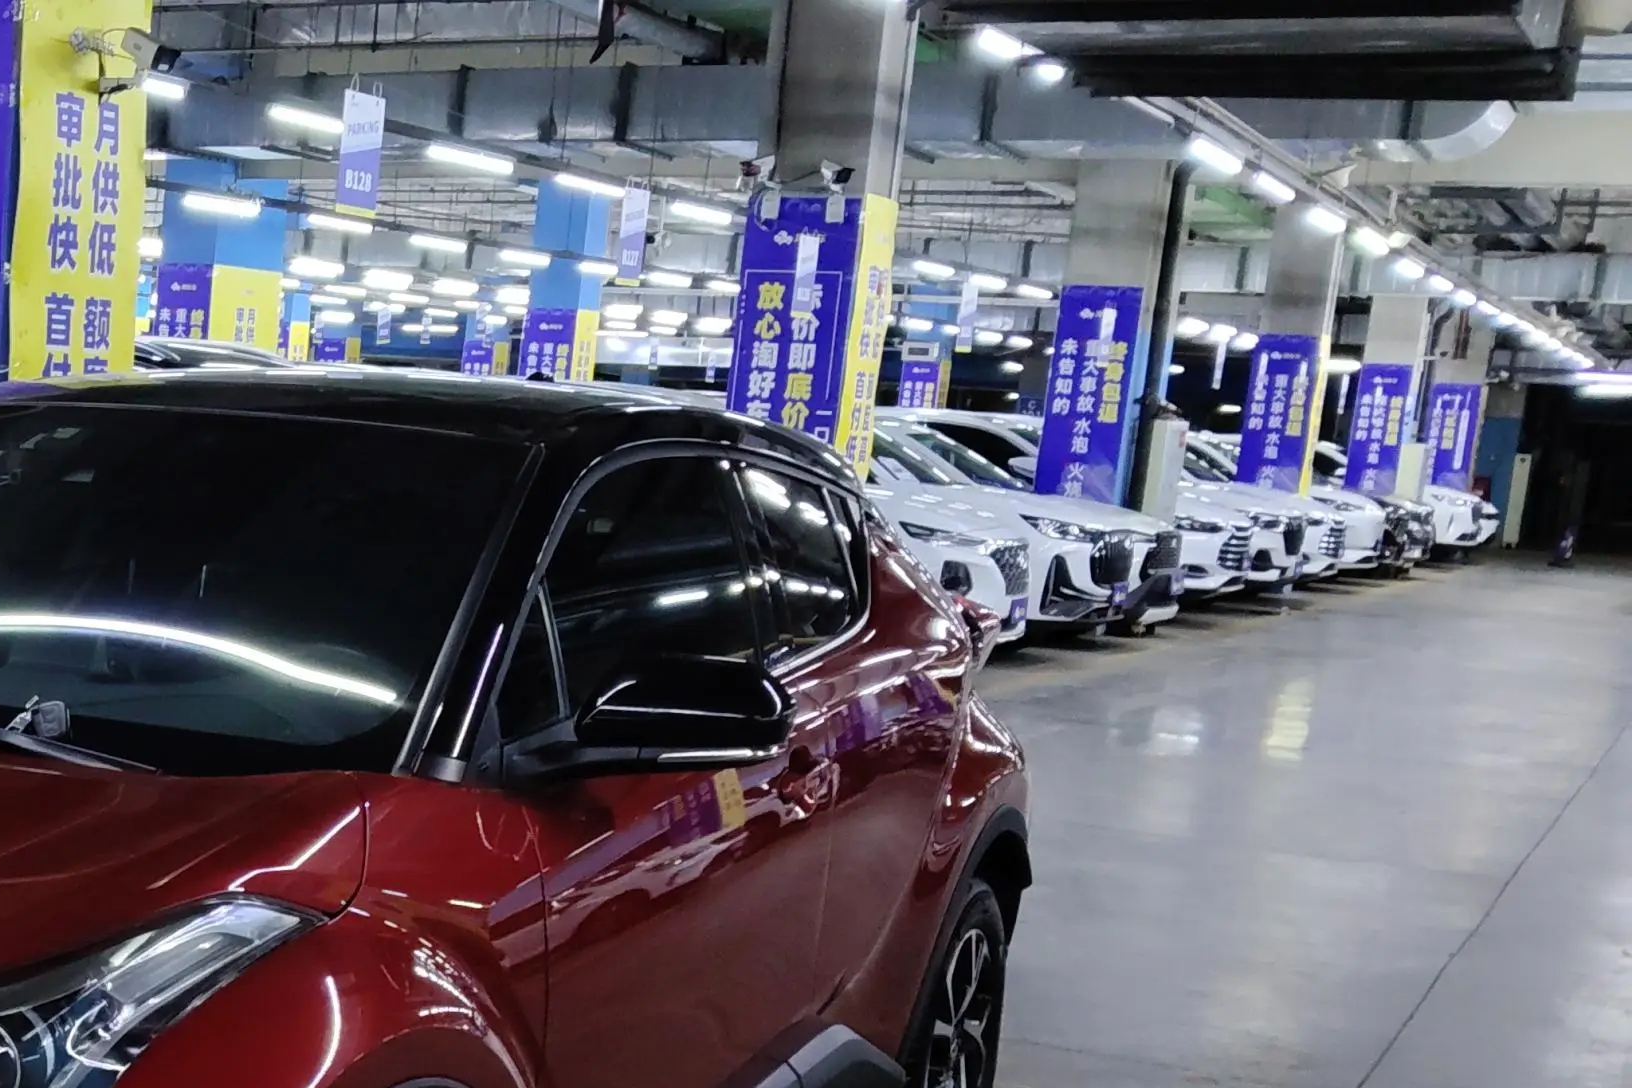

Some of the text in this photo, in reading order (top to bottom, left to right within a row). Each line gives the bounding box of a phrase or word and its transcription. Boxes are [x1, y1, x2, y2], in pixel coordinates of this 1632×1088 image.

[47, 92, 85, 270] 审批快
[88, 101, 120, 275] 月供低
[345, 169, 372, 192] B128
[746, 282, 786, 420] 放心淘好车
[1051, 337, 1079, 416] 未告知的
[1071, 417, 1091, 455] 水泡
